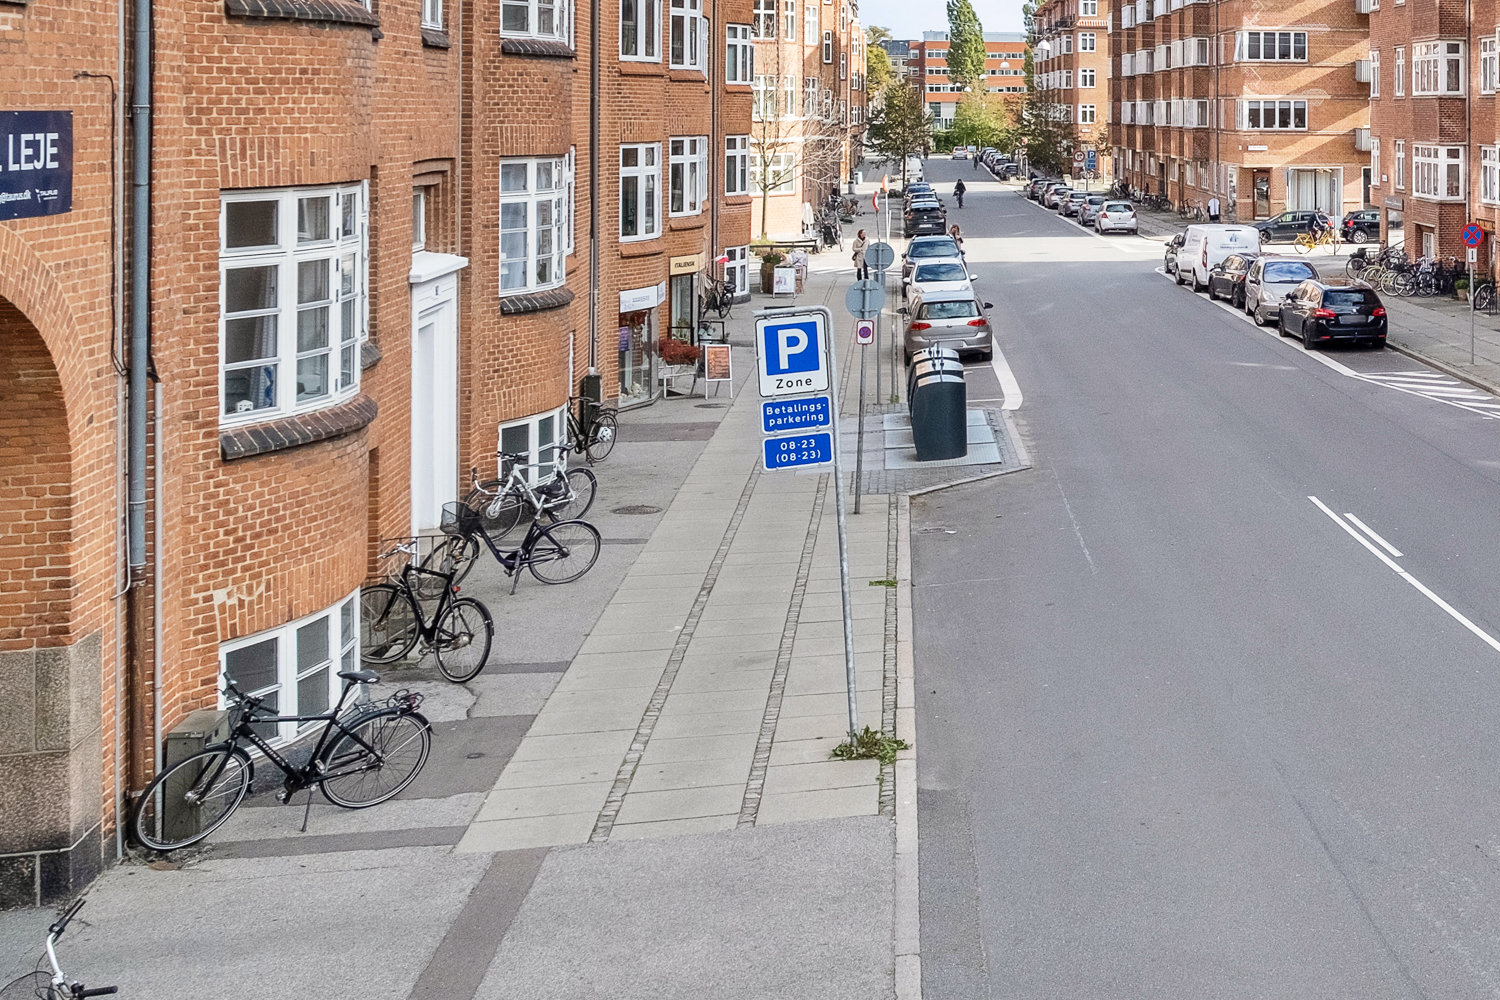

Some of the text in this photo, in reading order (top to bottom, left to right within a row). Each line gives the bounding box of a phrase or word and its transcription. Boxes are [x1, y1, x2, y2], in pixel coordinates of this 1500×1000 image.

[8, 132, 59, 171] LEJE
[777, 328, 809, 370] P
[776, 378, 812, 389] Zone
[766, 402, 826, 415] Betalings-
[769, 413, 824, 427] parkering
[780, 439, 816, 450] 08-23
[776, 449, 821, 463] (08-23)
